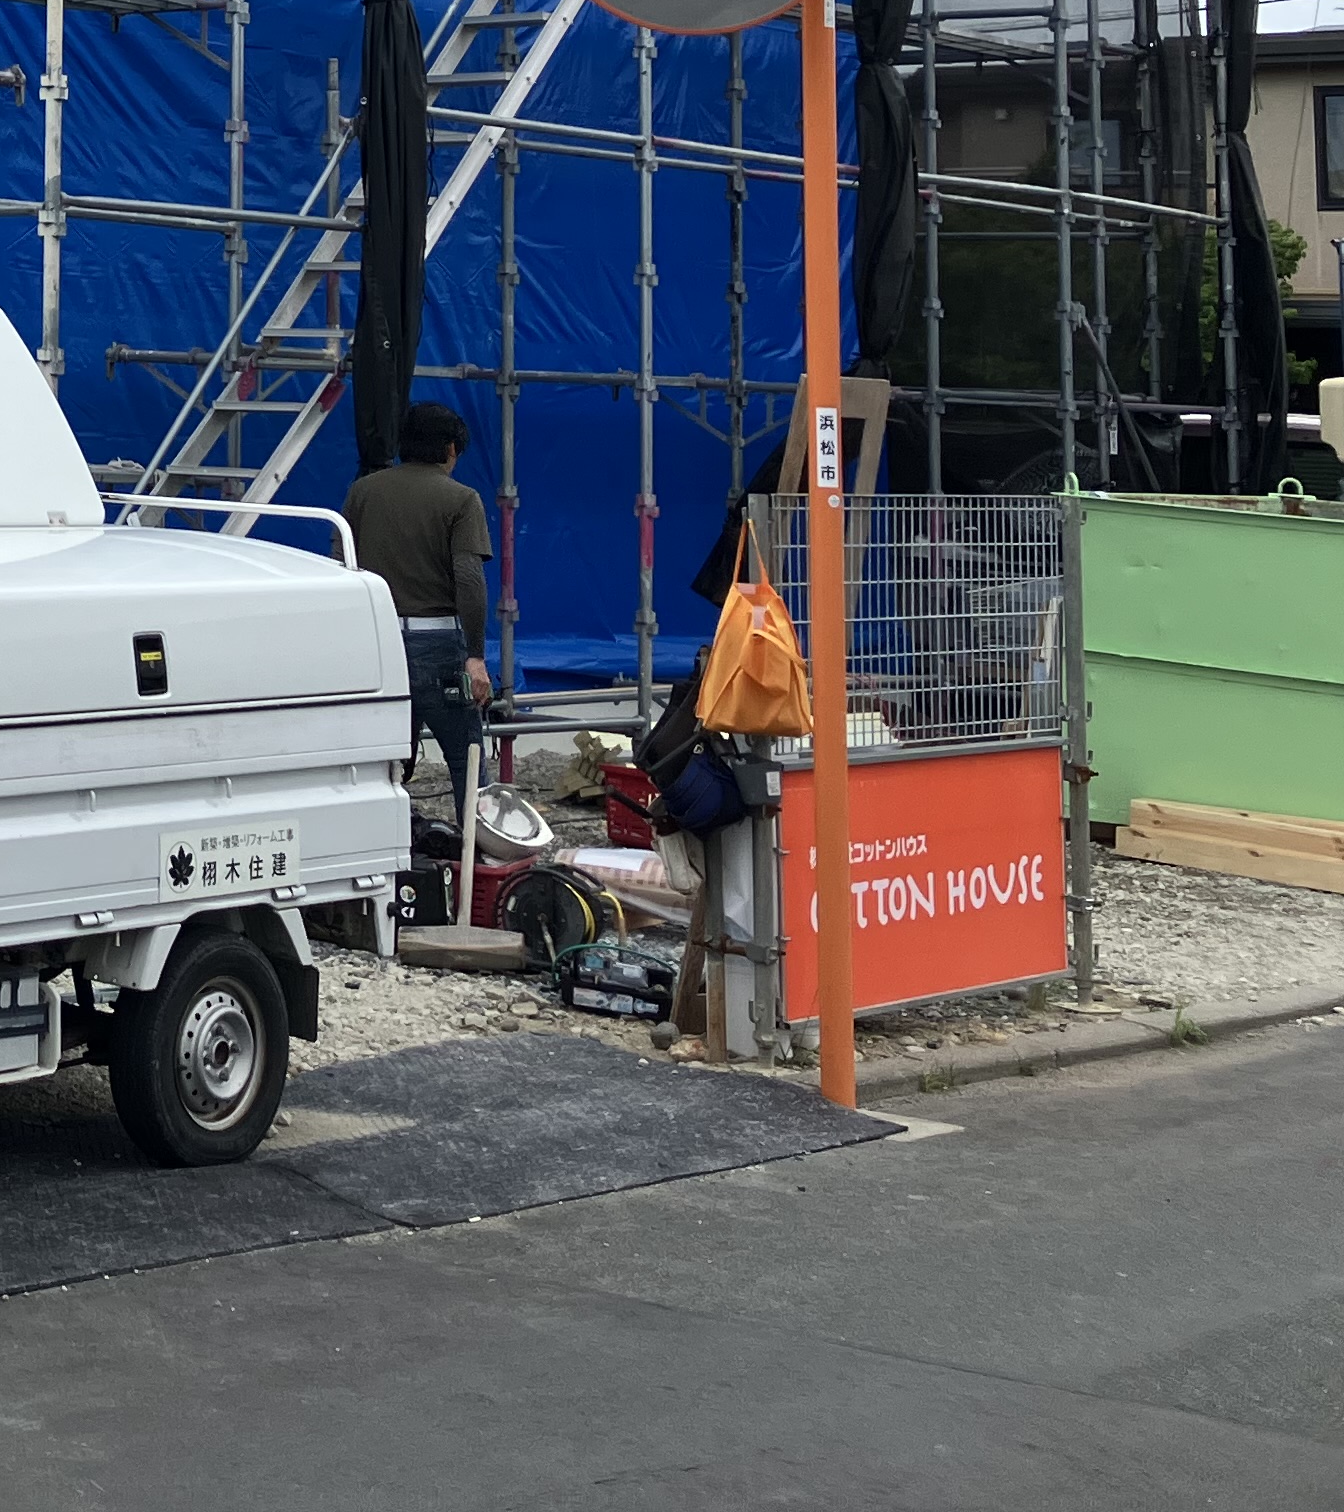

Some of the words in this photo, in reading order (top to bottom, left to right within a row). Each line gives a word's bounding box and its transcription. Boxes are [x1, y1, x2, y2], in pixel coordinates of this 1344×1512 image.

[819, 414, 835, 481] 浜松市
[946, 854, 1045, 916] HOUSE
